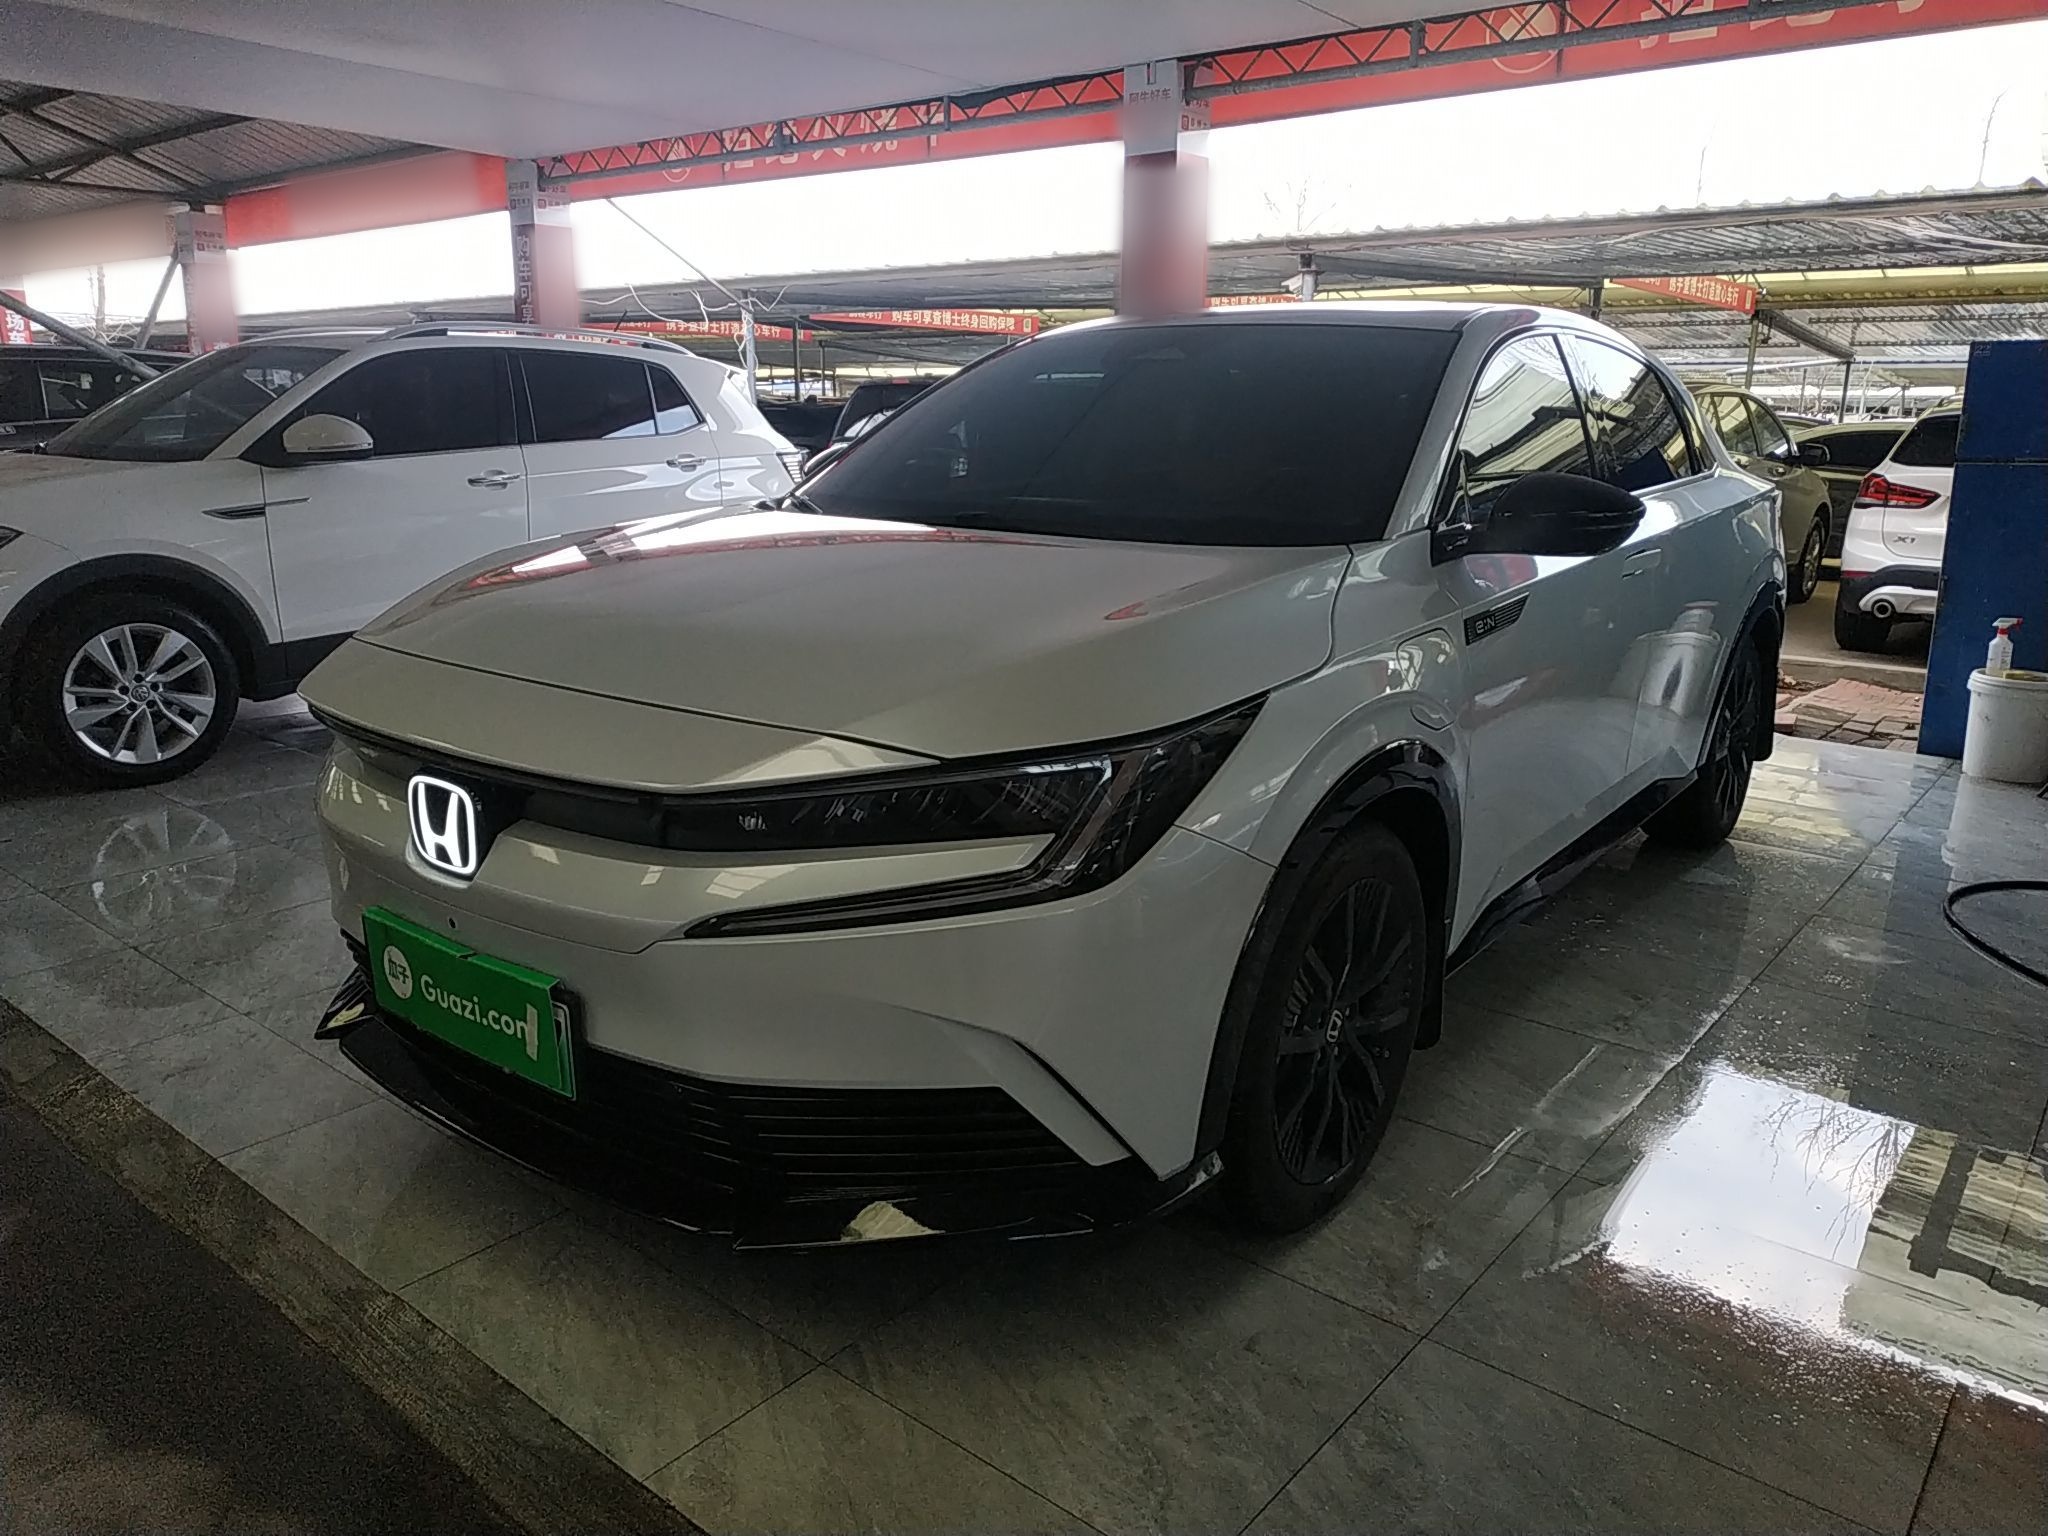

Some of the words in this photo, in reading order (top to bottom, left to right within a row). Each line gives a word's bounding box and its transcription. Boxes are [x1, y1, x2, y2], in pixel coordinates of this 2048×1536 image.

[516, 234, 535, 325] 购车可享
[666, 321, 781, 338] 携手查博士打造心车行
[891, 310, 1016, 331] 购车可享查博士终身回购保障
